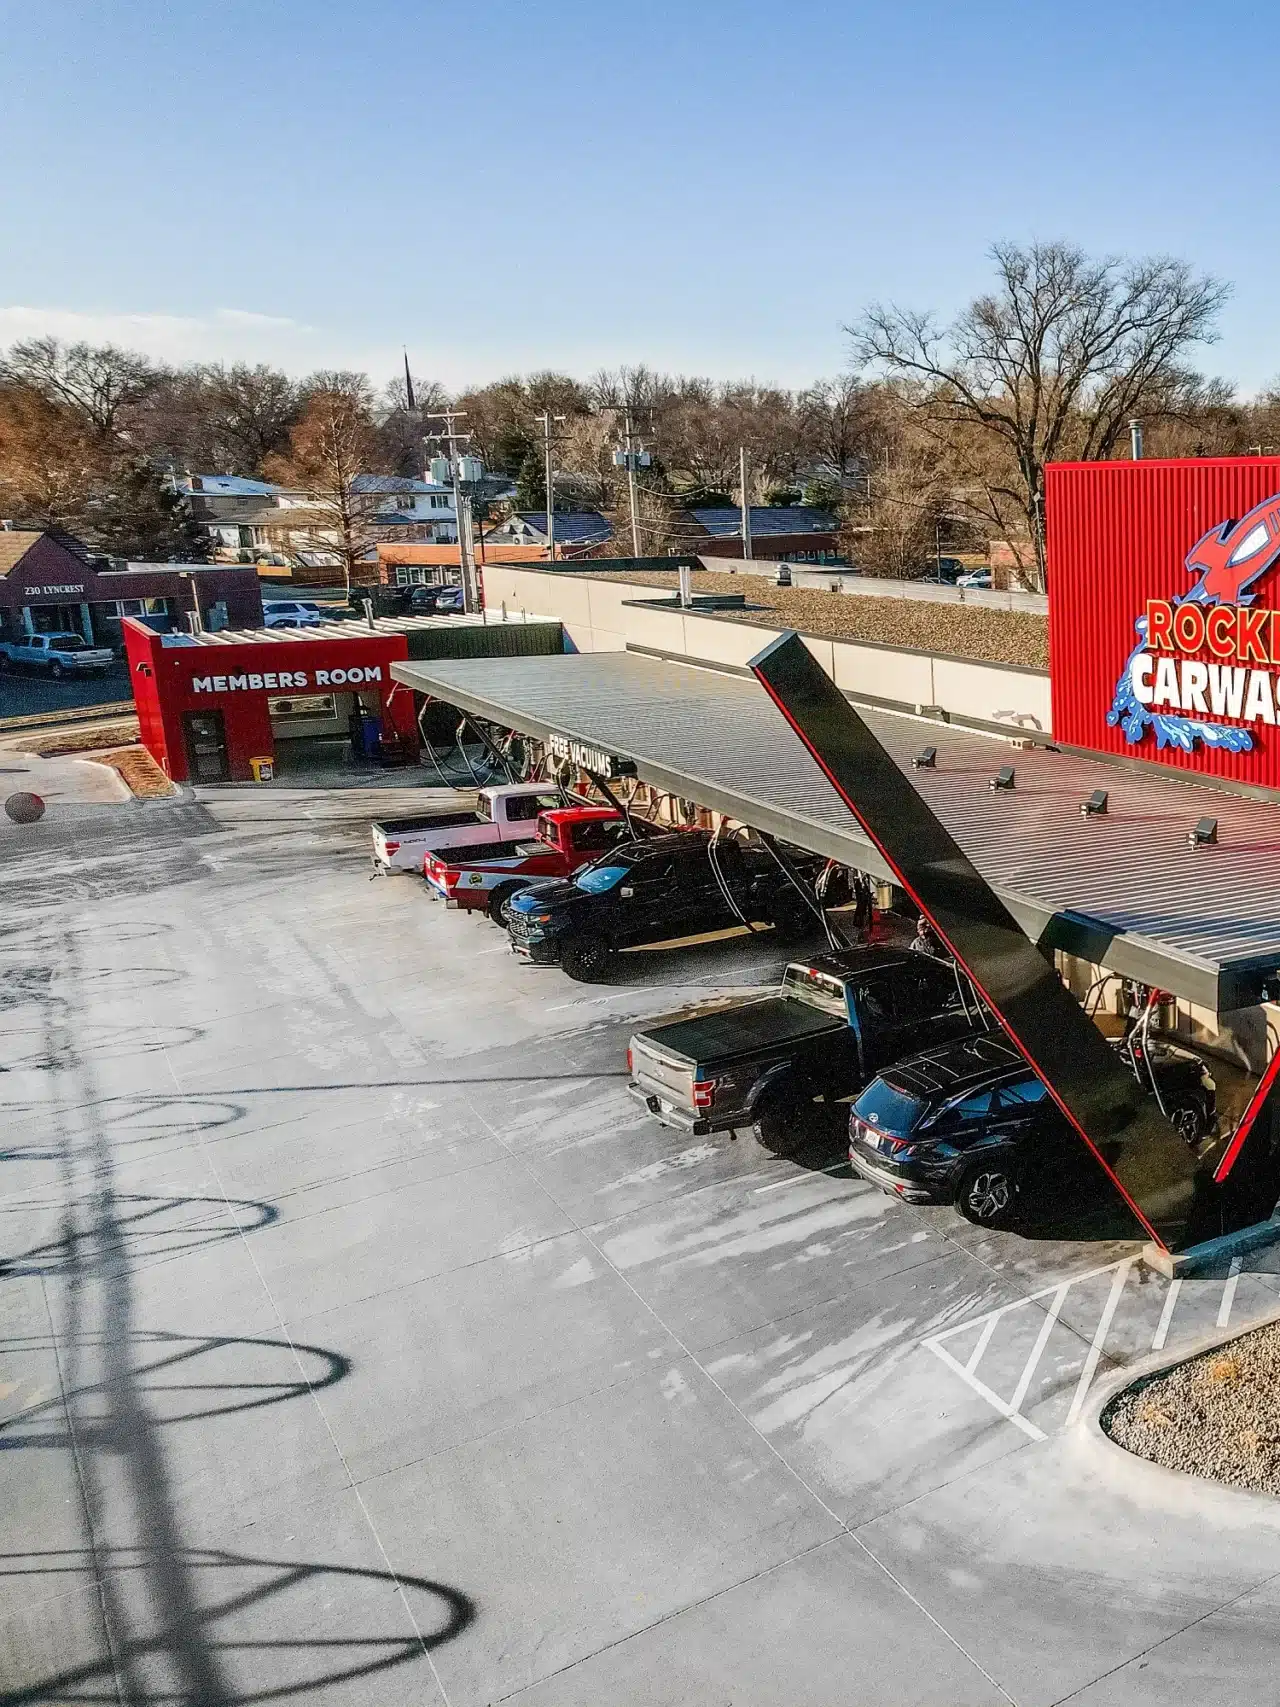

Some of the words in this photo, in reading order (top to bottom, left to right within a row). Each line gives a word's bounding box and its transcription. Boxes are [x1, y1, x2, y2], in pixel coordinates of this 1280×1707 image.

[24, 587, 40, 595] 230
[43, 585, 84, 594] LYNCREST
[192, 671, 308, 693] MEMBERS
[315, 666, 382, 686] ROOM
[549, 733, 569, 760] FREE
[570, 741, 612, 778] VACUUMS
